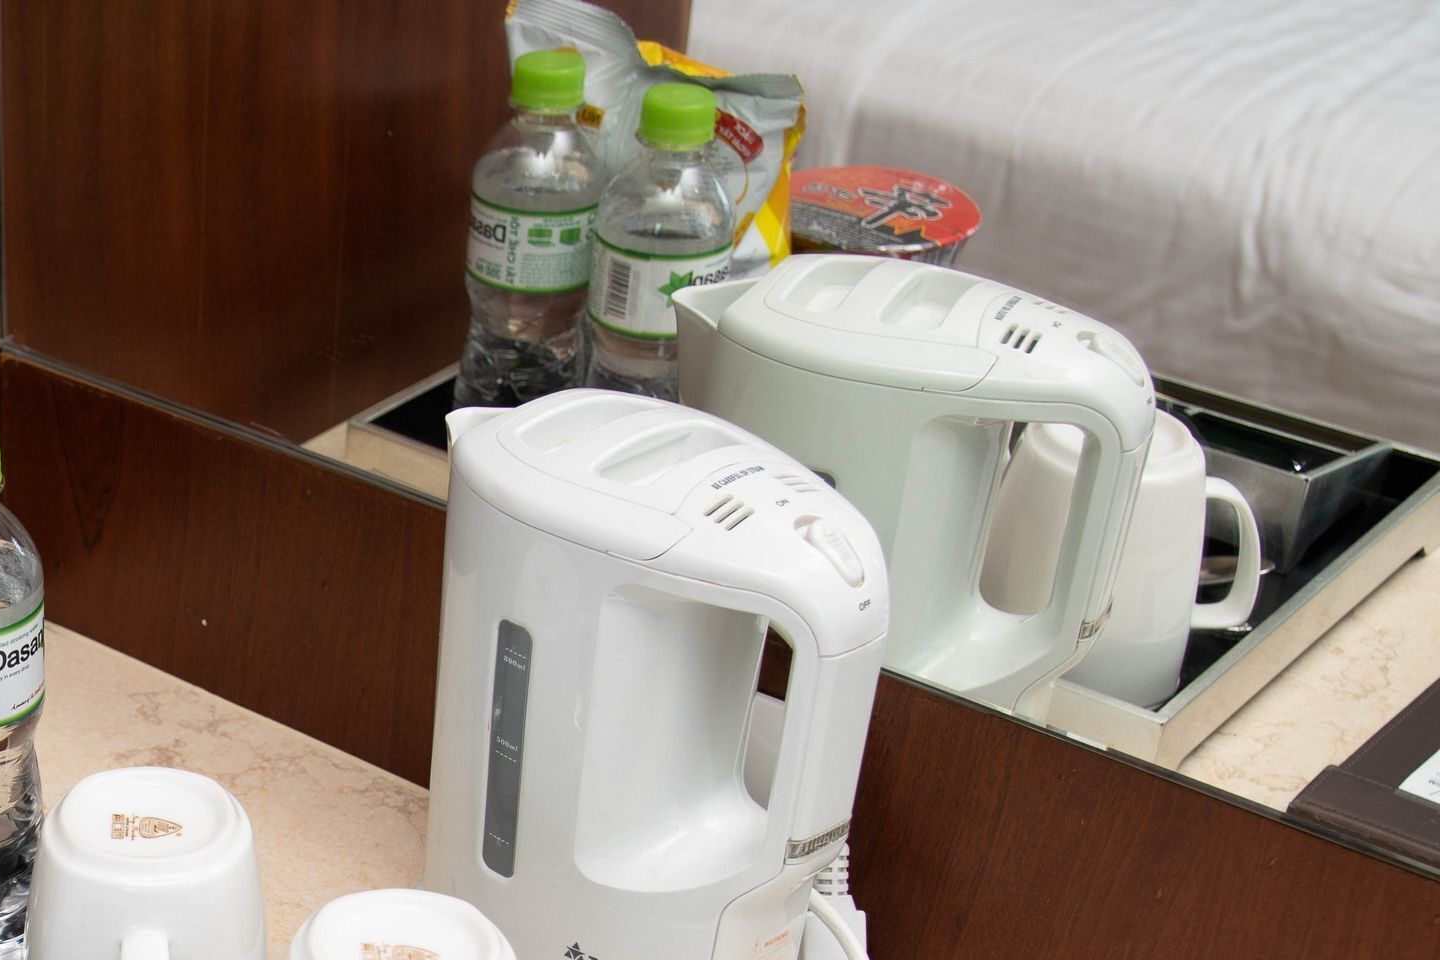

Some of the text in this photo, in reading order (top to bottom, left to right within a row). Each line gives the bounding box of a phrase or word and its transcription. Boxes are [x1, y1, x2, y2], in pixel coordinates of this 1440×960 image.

[776, 498, 790, 507] ON
[858, 599, 871, 611] OFF
[503, 654, 526, 672] 800ml
[496, 735, 519, 753] 500ml
